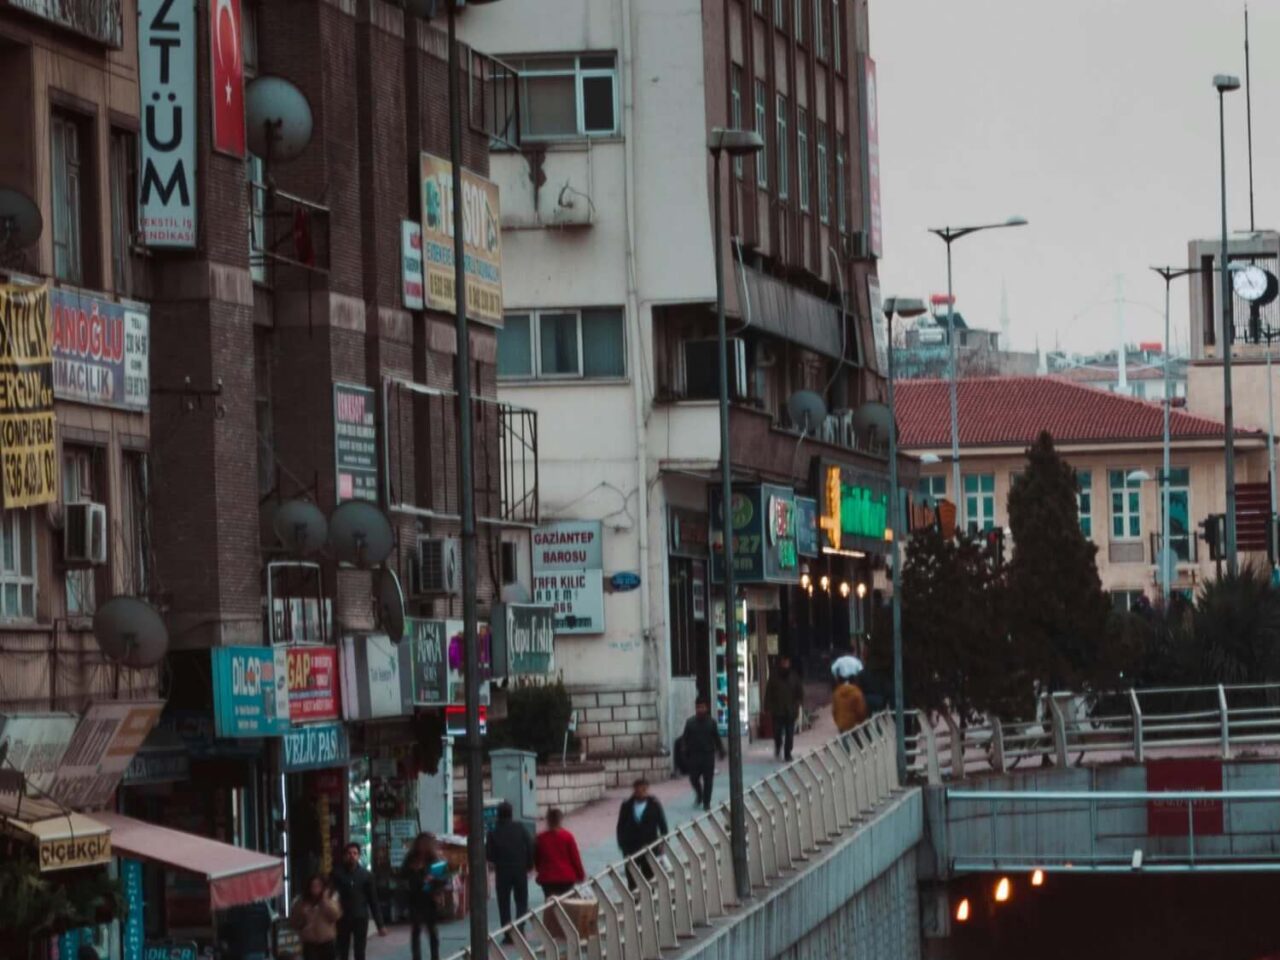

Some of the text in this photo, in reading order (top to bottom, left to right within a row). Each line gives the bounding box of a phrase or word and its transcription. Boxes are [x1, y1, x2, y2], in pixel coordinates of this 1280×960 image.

[534, 531, 594, 545] GAZİANTEP
[543, 550, 586, 564] BAROSU
[287, 652, 311, 690] GAP
